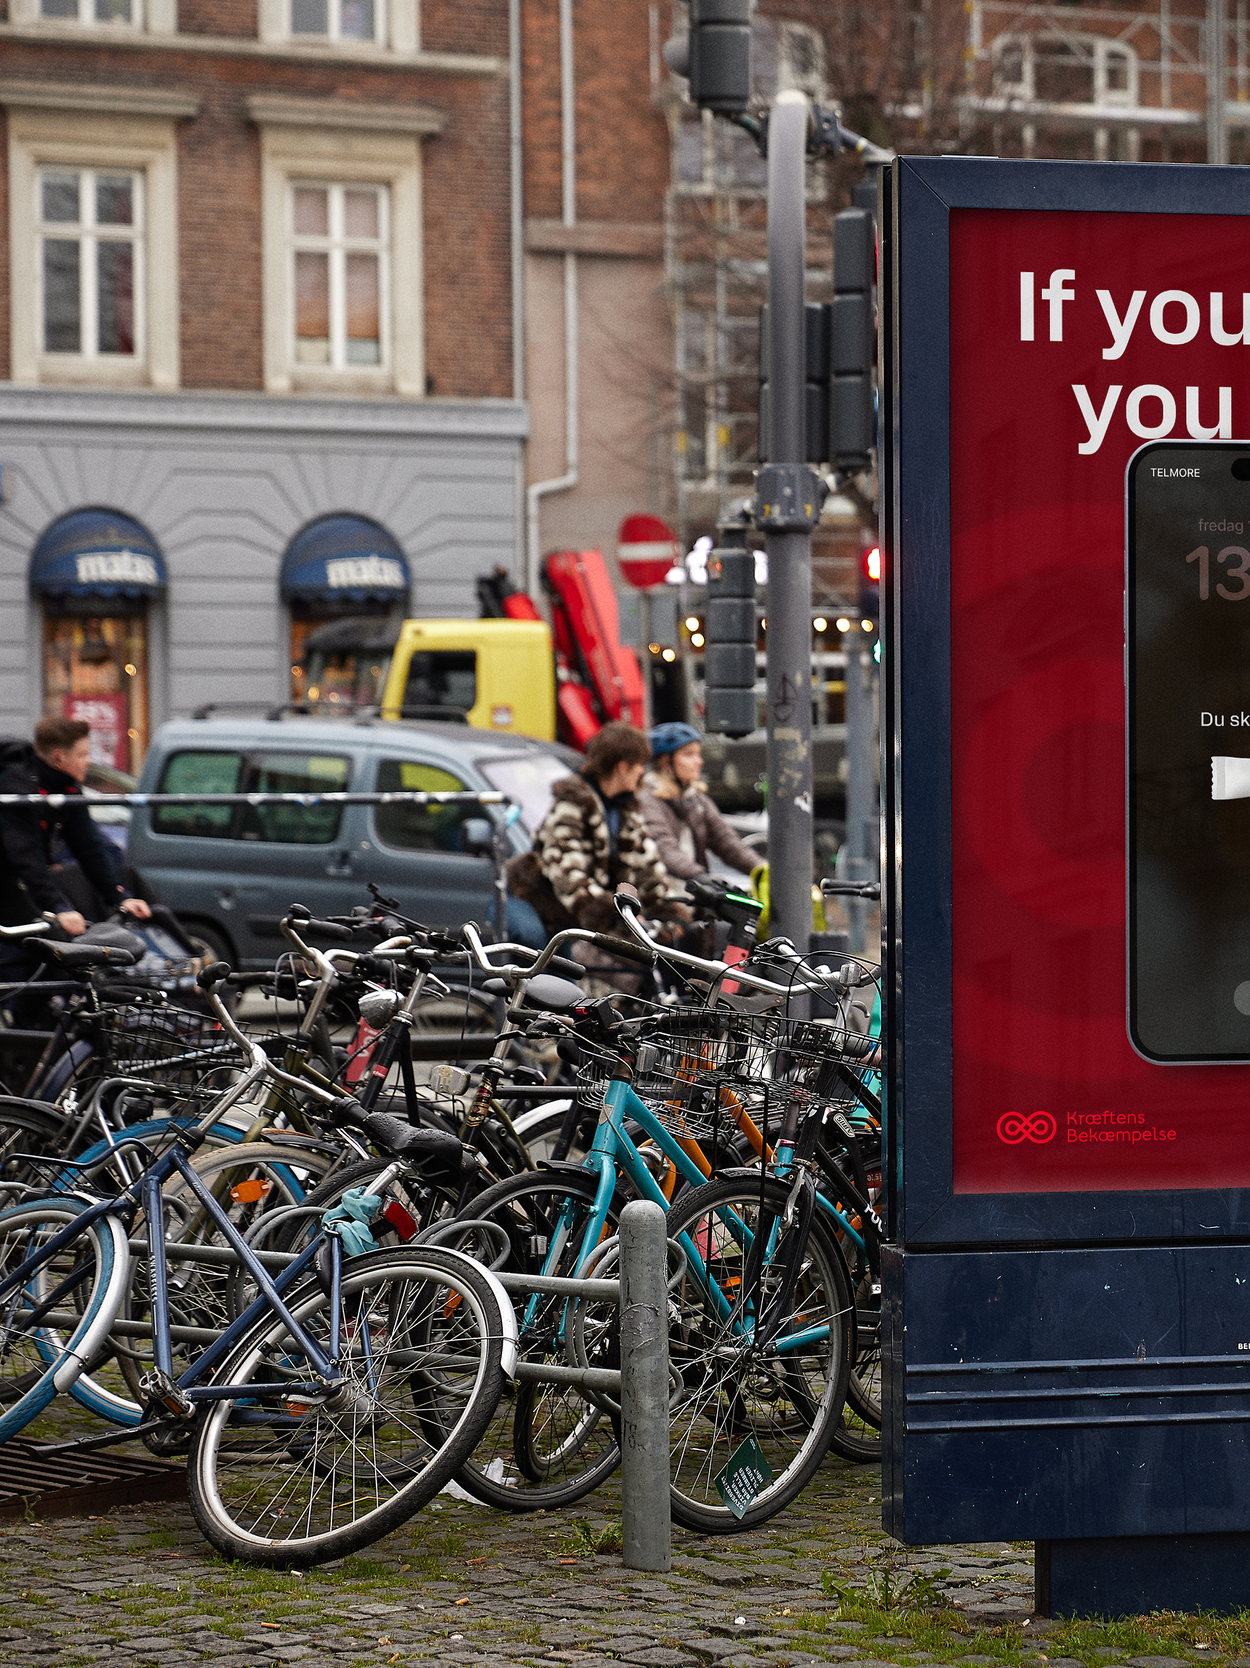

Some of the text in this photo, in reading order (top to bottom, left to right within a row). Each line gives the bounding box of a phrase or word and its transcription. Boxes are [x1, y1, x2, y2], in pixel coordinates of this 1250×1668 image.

[1020, 268, 1076, 342] If
[1071, 383, 1233, 455] you
[1150, 467, 1201, 478] TELMORE
[1198, 518, 1245, 535] fredag
[1200, 711, 1226, 727] Du
[1066, 1110, 1146, 1126] Kræftens
[1066, 1126, 1178, 1145] Bekæmpelse
